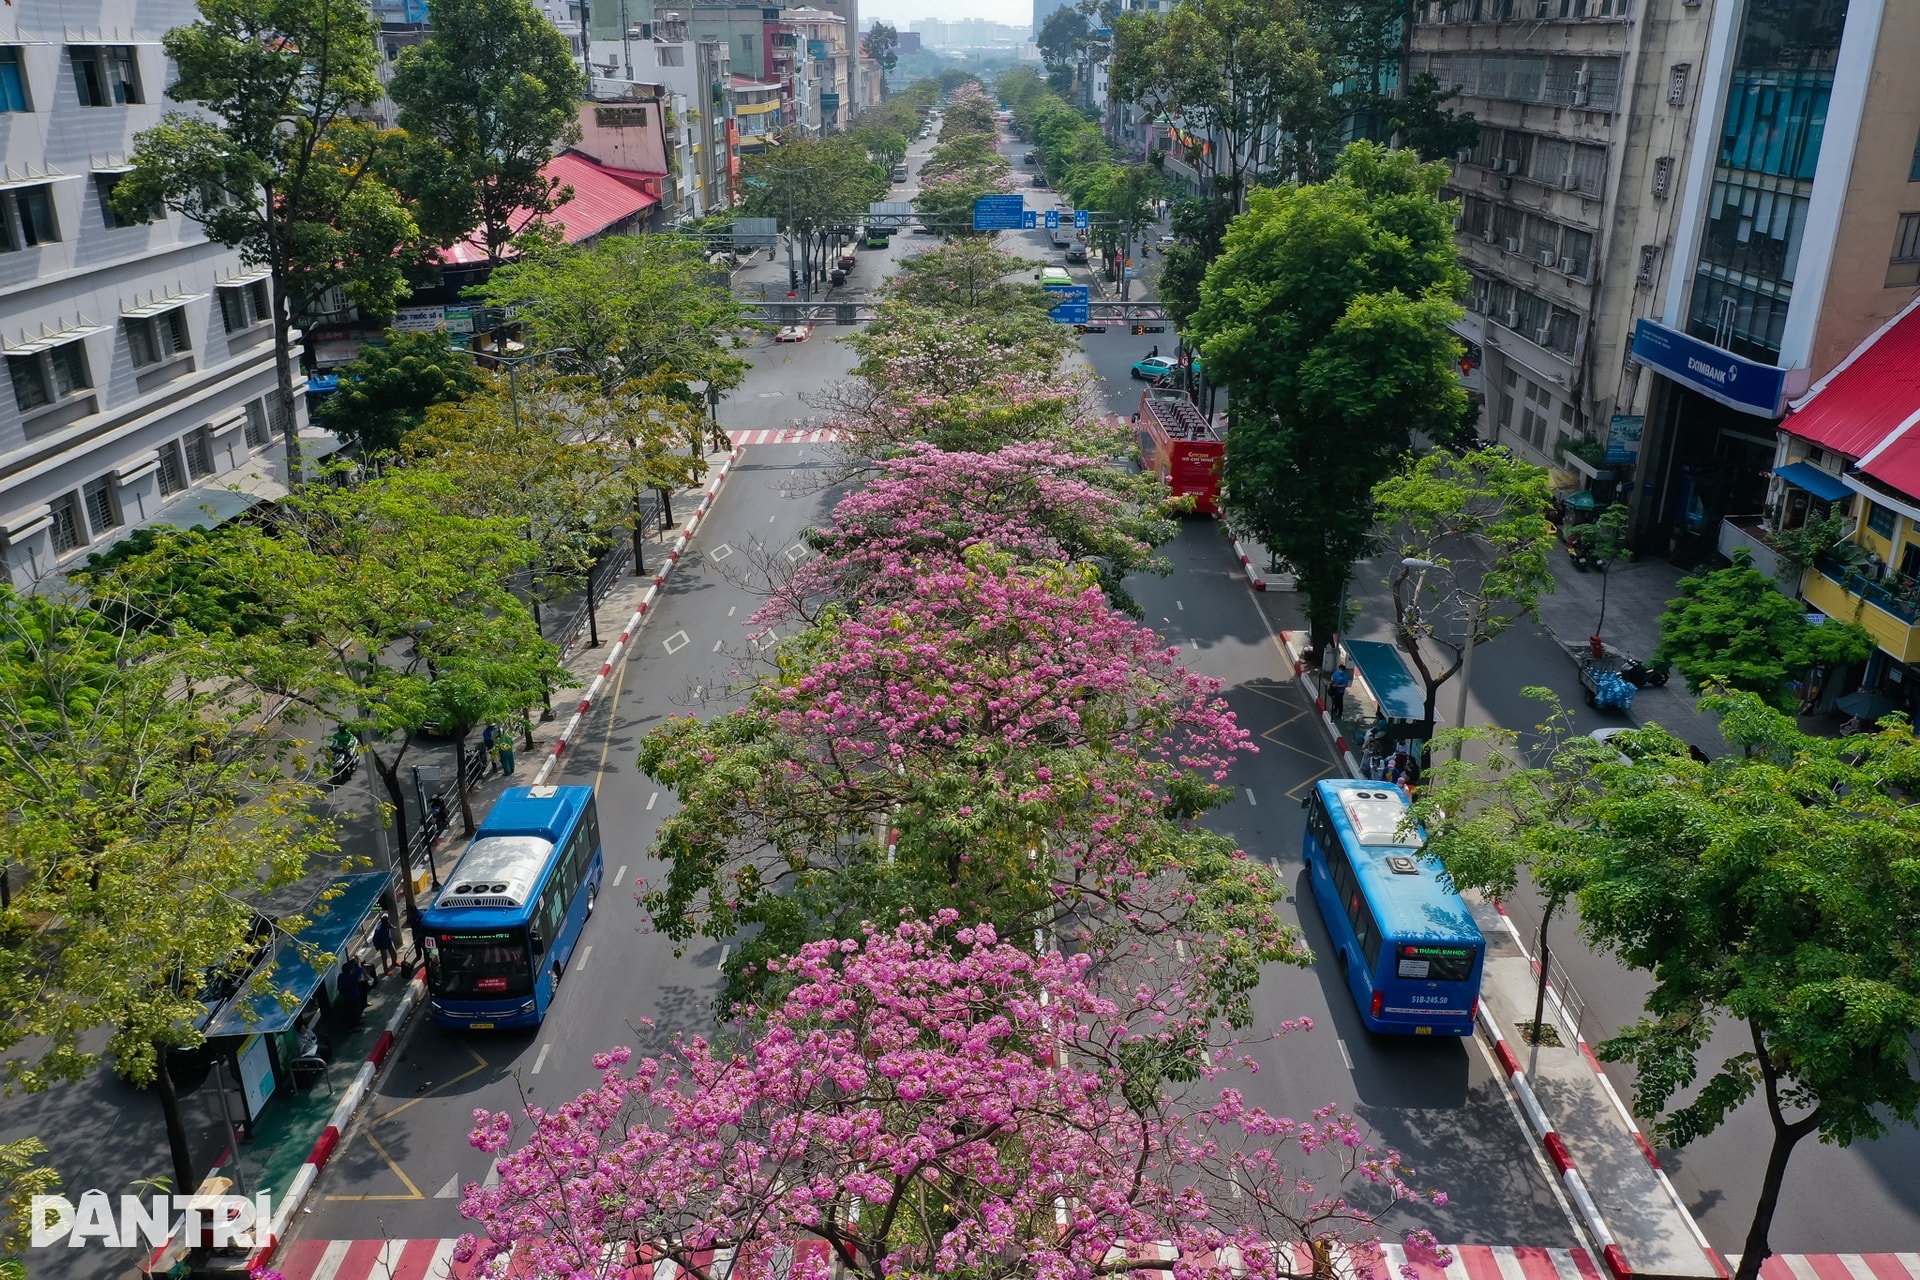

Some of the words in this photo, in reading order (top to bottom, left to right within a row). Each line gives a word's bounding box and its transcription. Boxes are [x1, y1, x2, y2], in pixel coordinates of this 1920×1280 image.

[1138, 325, 1144, 335] 3
[1688, 357, 1726, 384] EXIMBANK
[1412, 996, 1448, 1004] 51B-245.50
